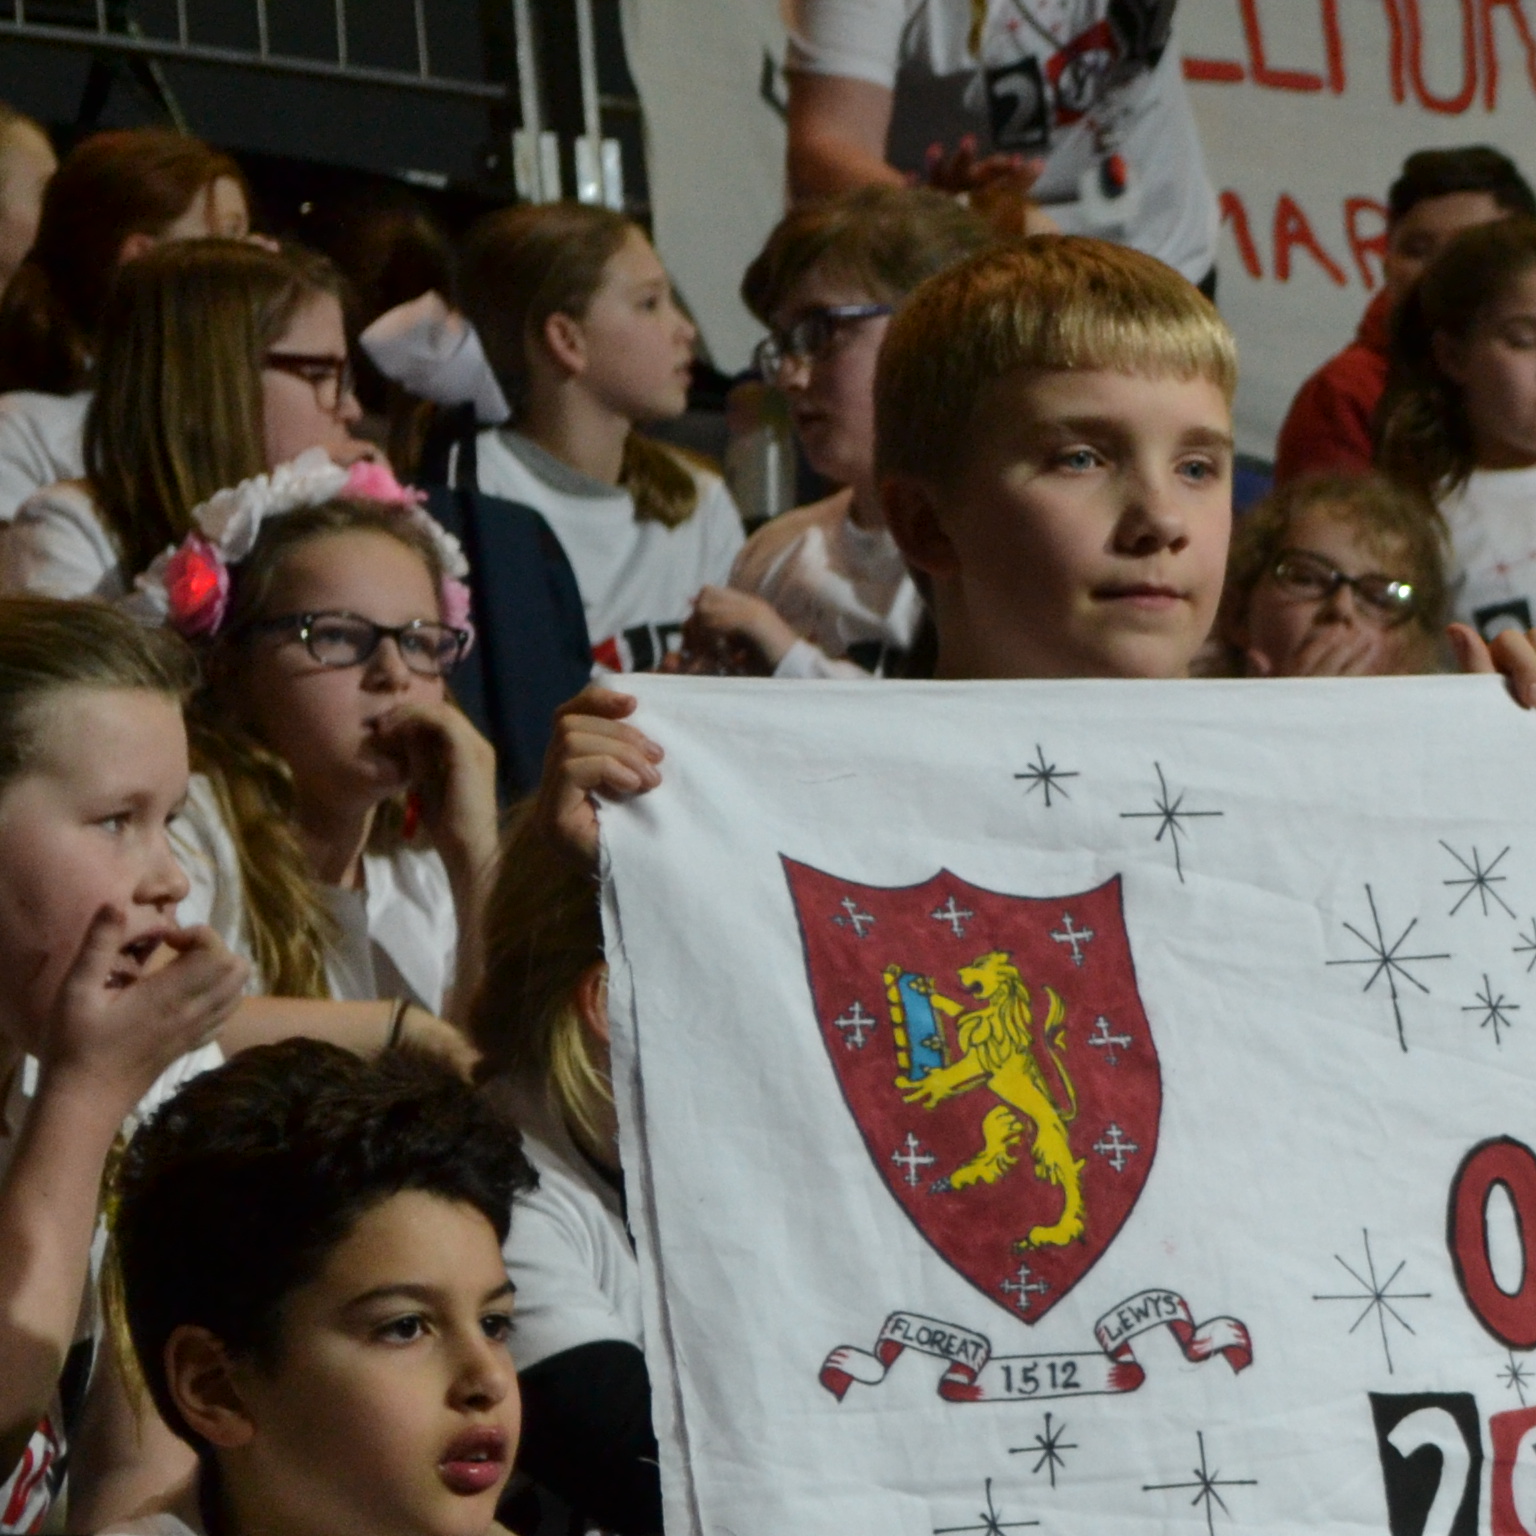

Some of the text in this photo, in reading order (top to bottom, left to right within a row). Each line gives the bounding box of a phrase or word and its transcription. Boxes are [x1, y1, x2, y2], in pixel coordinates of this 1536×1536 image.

[890, 1317, 983, 1361] FLOREAT
[1103, 1293, 1178, 1342] LEWYS
[1000, 1361, 1082, 1395] 1512
